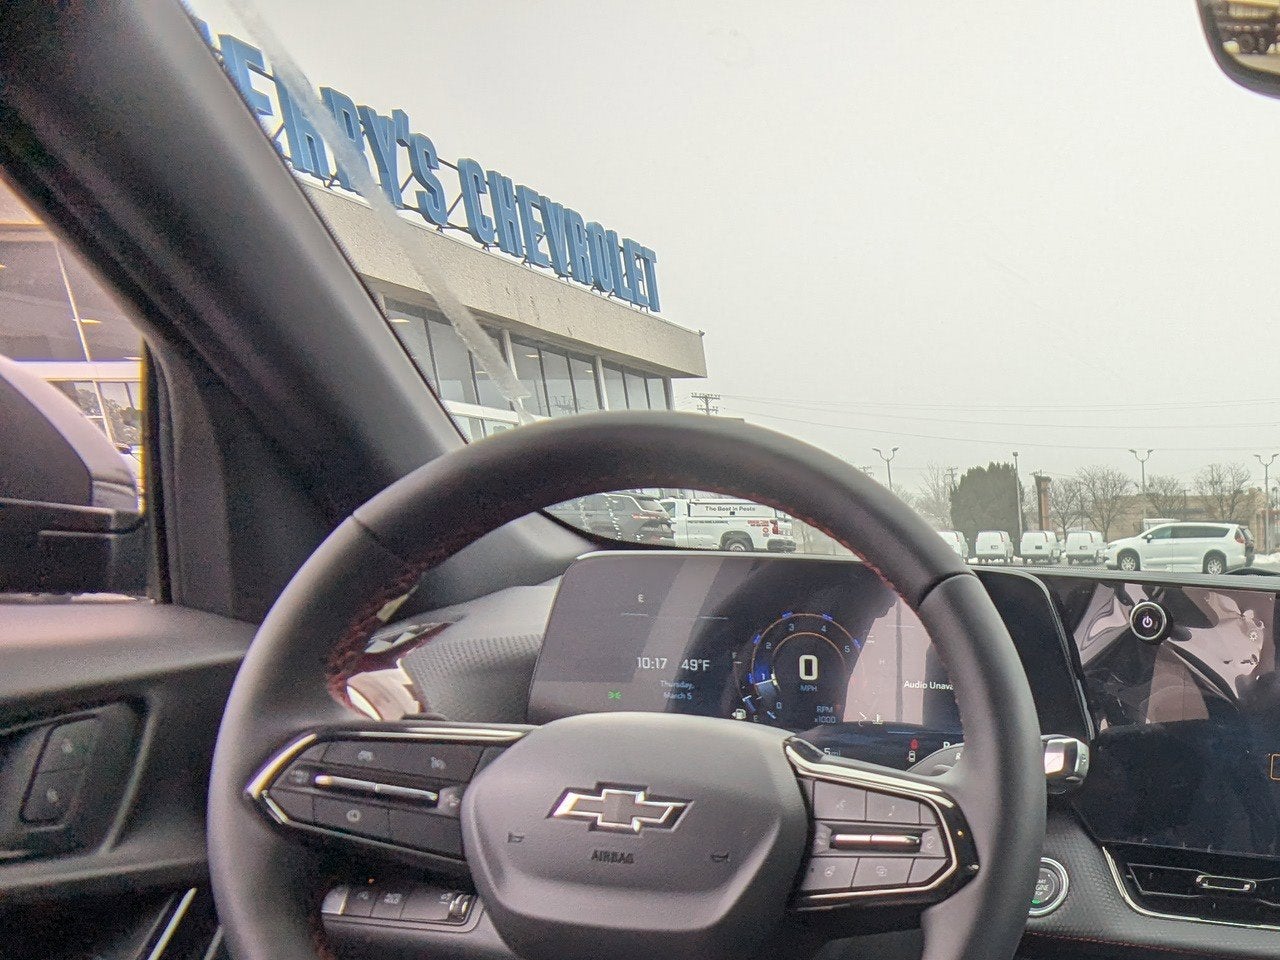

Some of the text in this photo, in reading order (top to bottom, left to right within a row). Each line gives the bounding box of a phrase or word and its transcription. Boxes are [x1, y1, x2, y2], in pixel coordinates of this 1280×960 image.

[200, 20, 661, 313] ERRY'S CHEVROLET
[788, 623, 795, 632] 3
[820, 624, 827, 633] 4
[765, 641, 772, 650] 2
[844, 645, 851, 653] 5
[637, 656, 710, 671] 10:17 49°F
[798, 654, 819, 681] 0
[799, 684, 818, 692] MPH
[903, 680, 928, 690] Audio
[663, 691, 694, 700] March 5
[816, 705, 834, 713] RPM
[591, 850, 635, 865] AIRBAG
